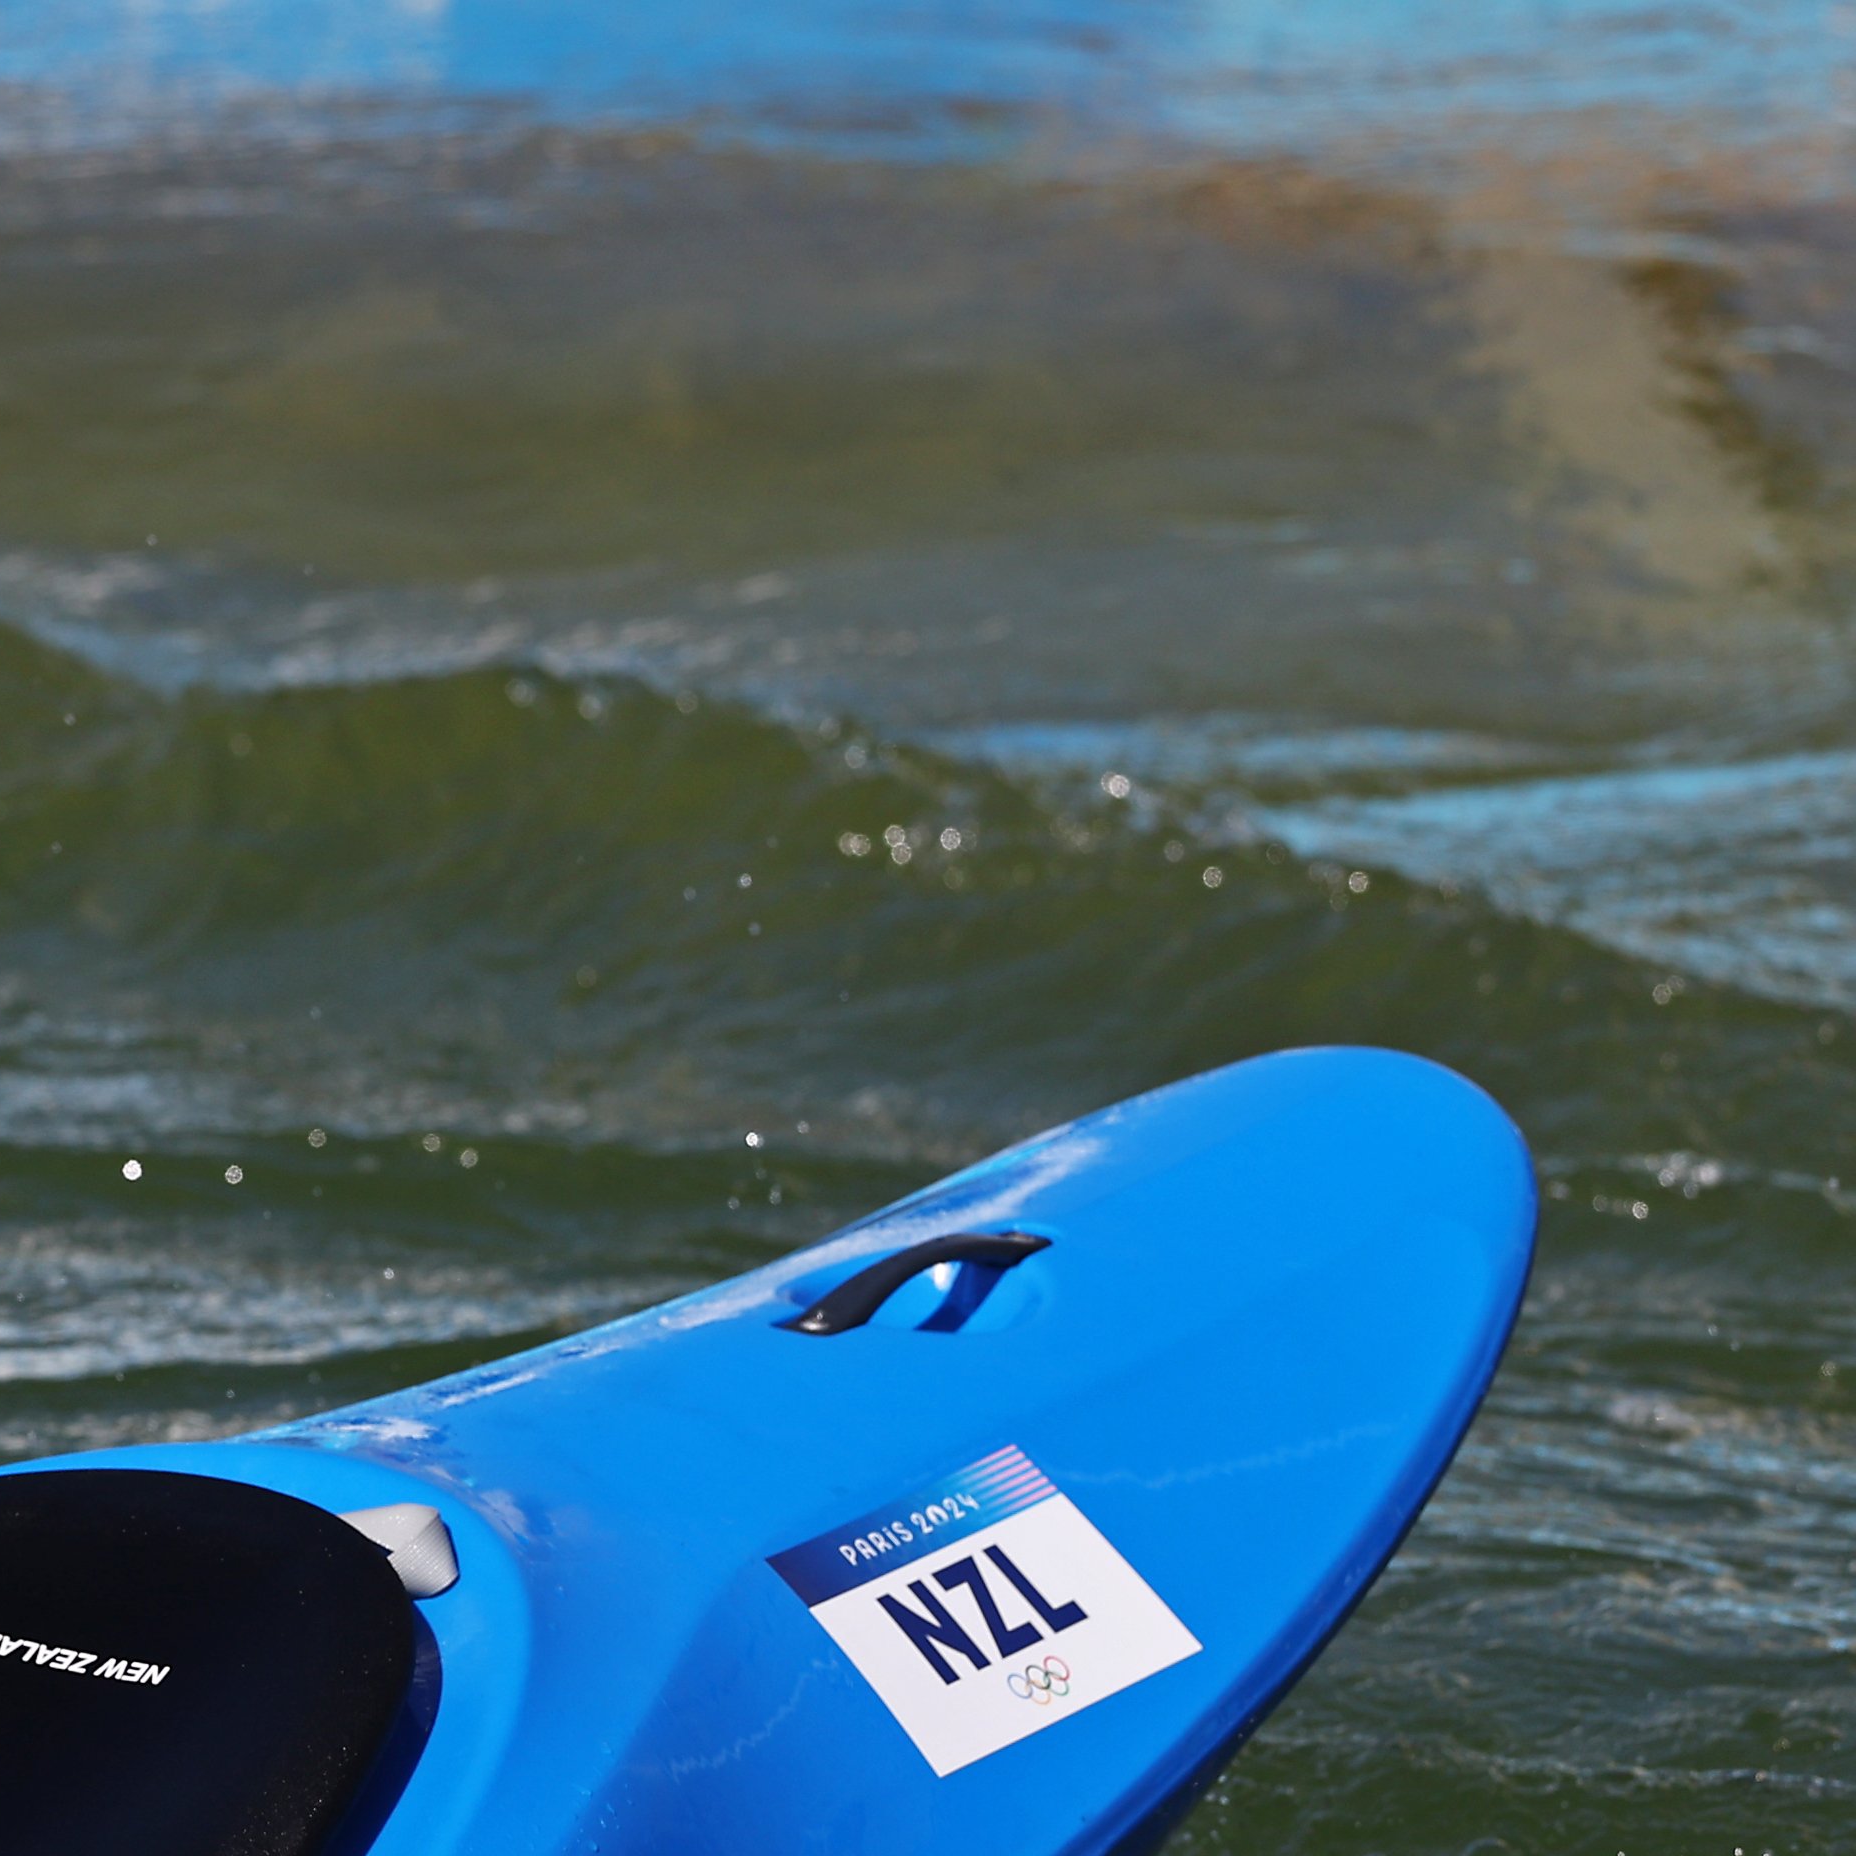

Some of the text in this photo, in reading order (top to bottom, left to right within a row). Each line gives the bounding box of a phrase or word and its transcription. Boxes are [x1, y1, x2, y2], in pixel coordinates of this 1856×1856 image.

[910, 1491, 979, 1534] 2024
[876, 1544, 1088, 1686] NZL
[93, 1658, 171, 1686] NEW
